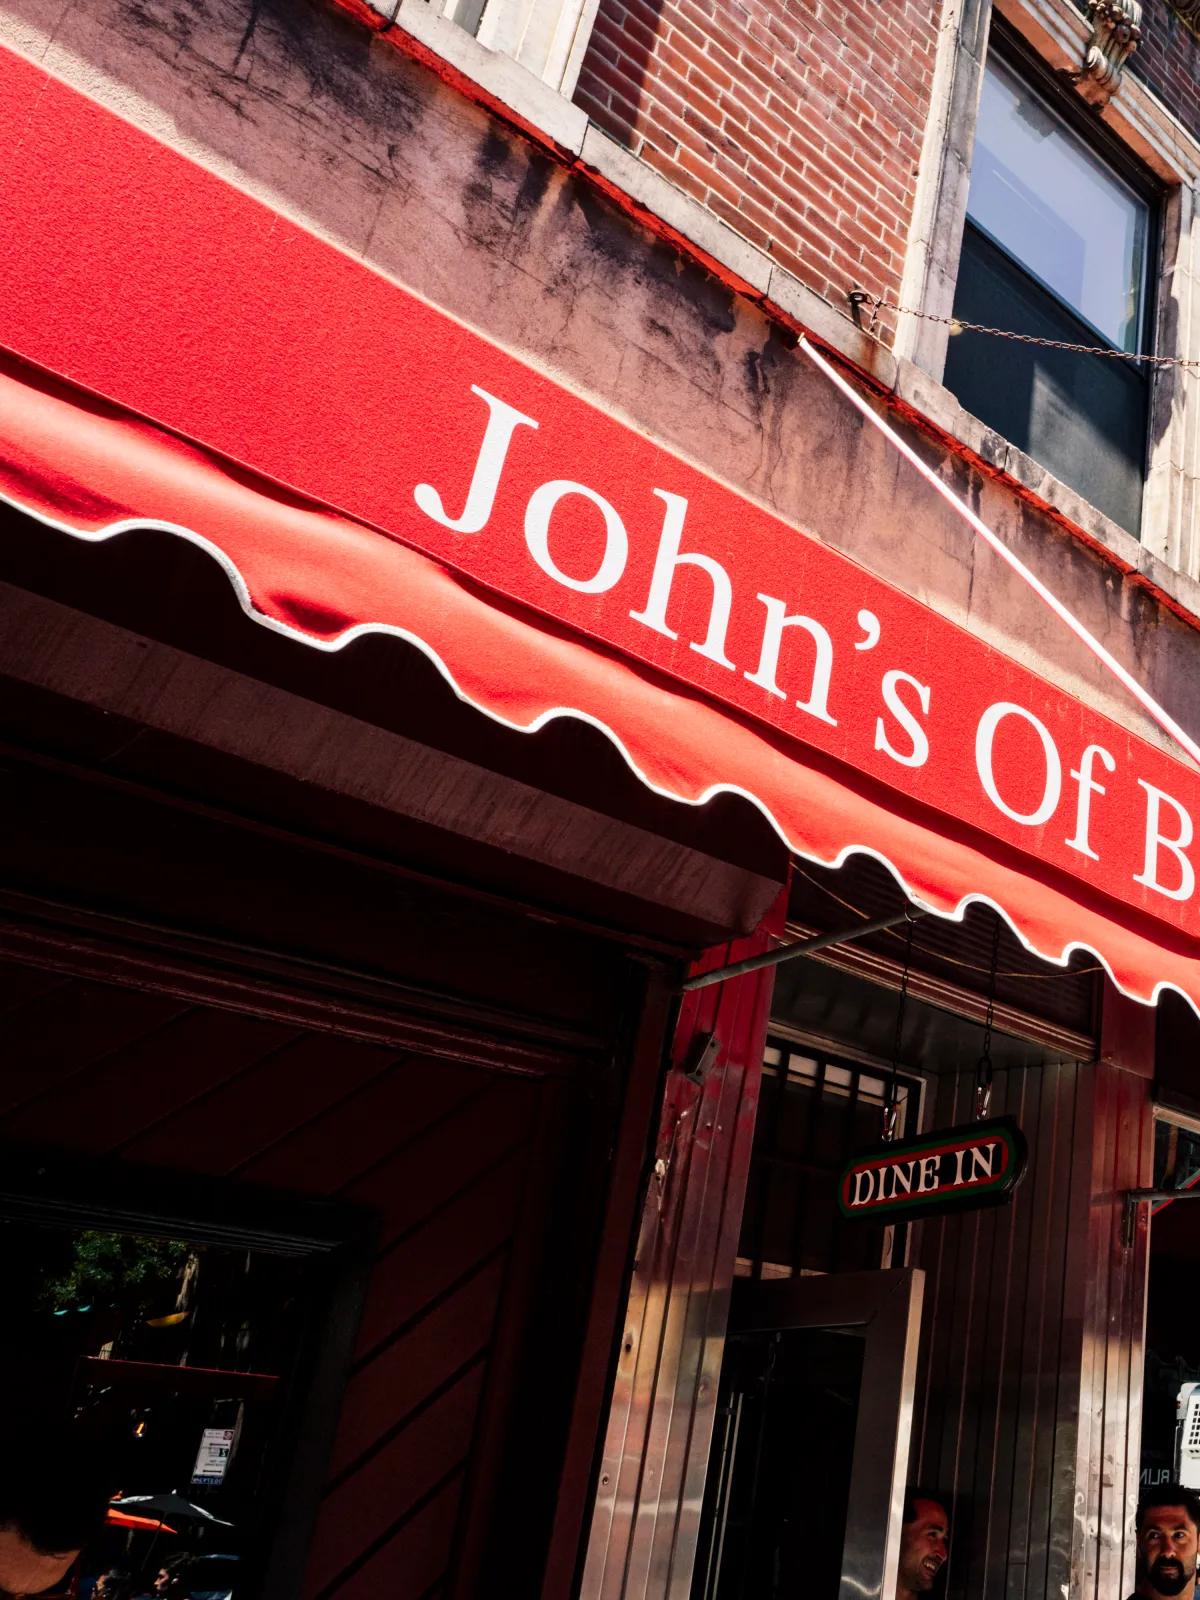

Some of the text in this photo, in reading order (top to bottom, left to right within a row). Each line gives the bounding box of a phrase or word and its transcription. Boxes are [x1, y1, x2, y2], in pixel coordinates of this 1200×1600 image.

[414, 384, 931, 768] John's
[974, 701, 1116, 861] Of
[851, 1143, 997, 1206] DINE IN
